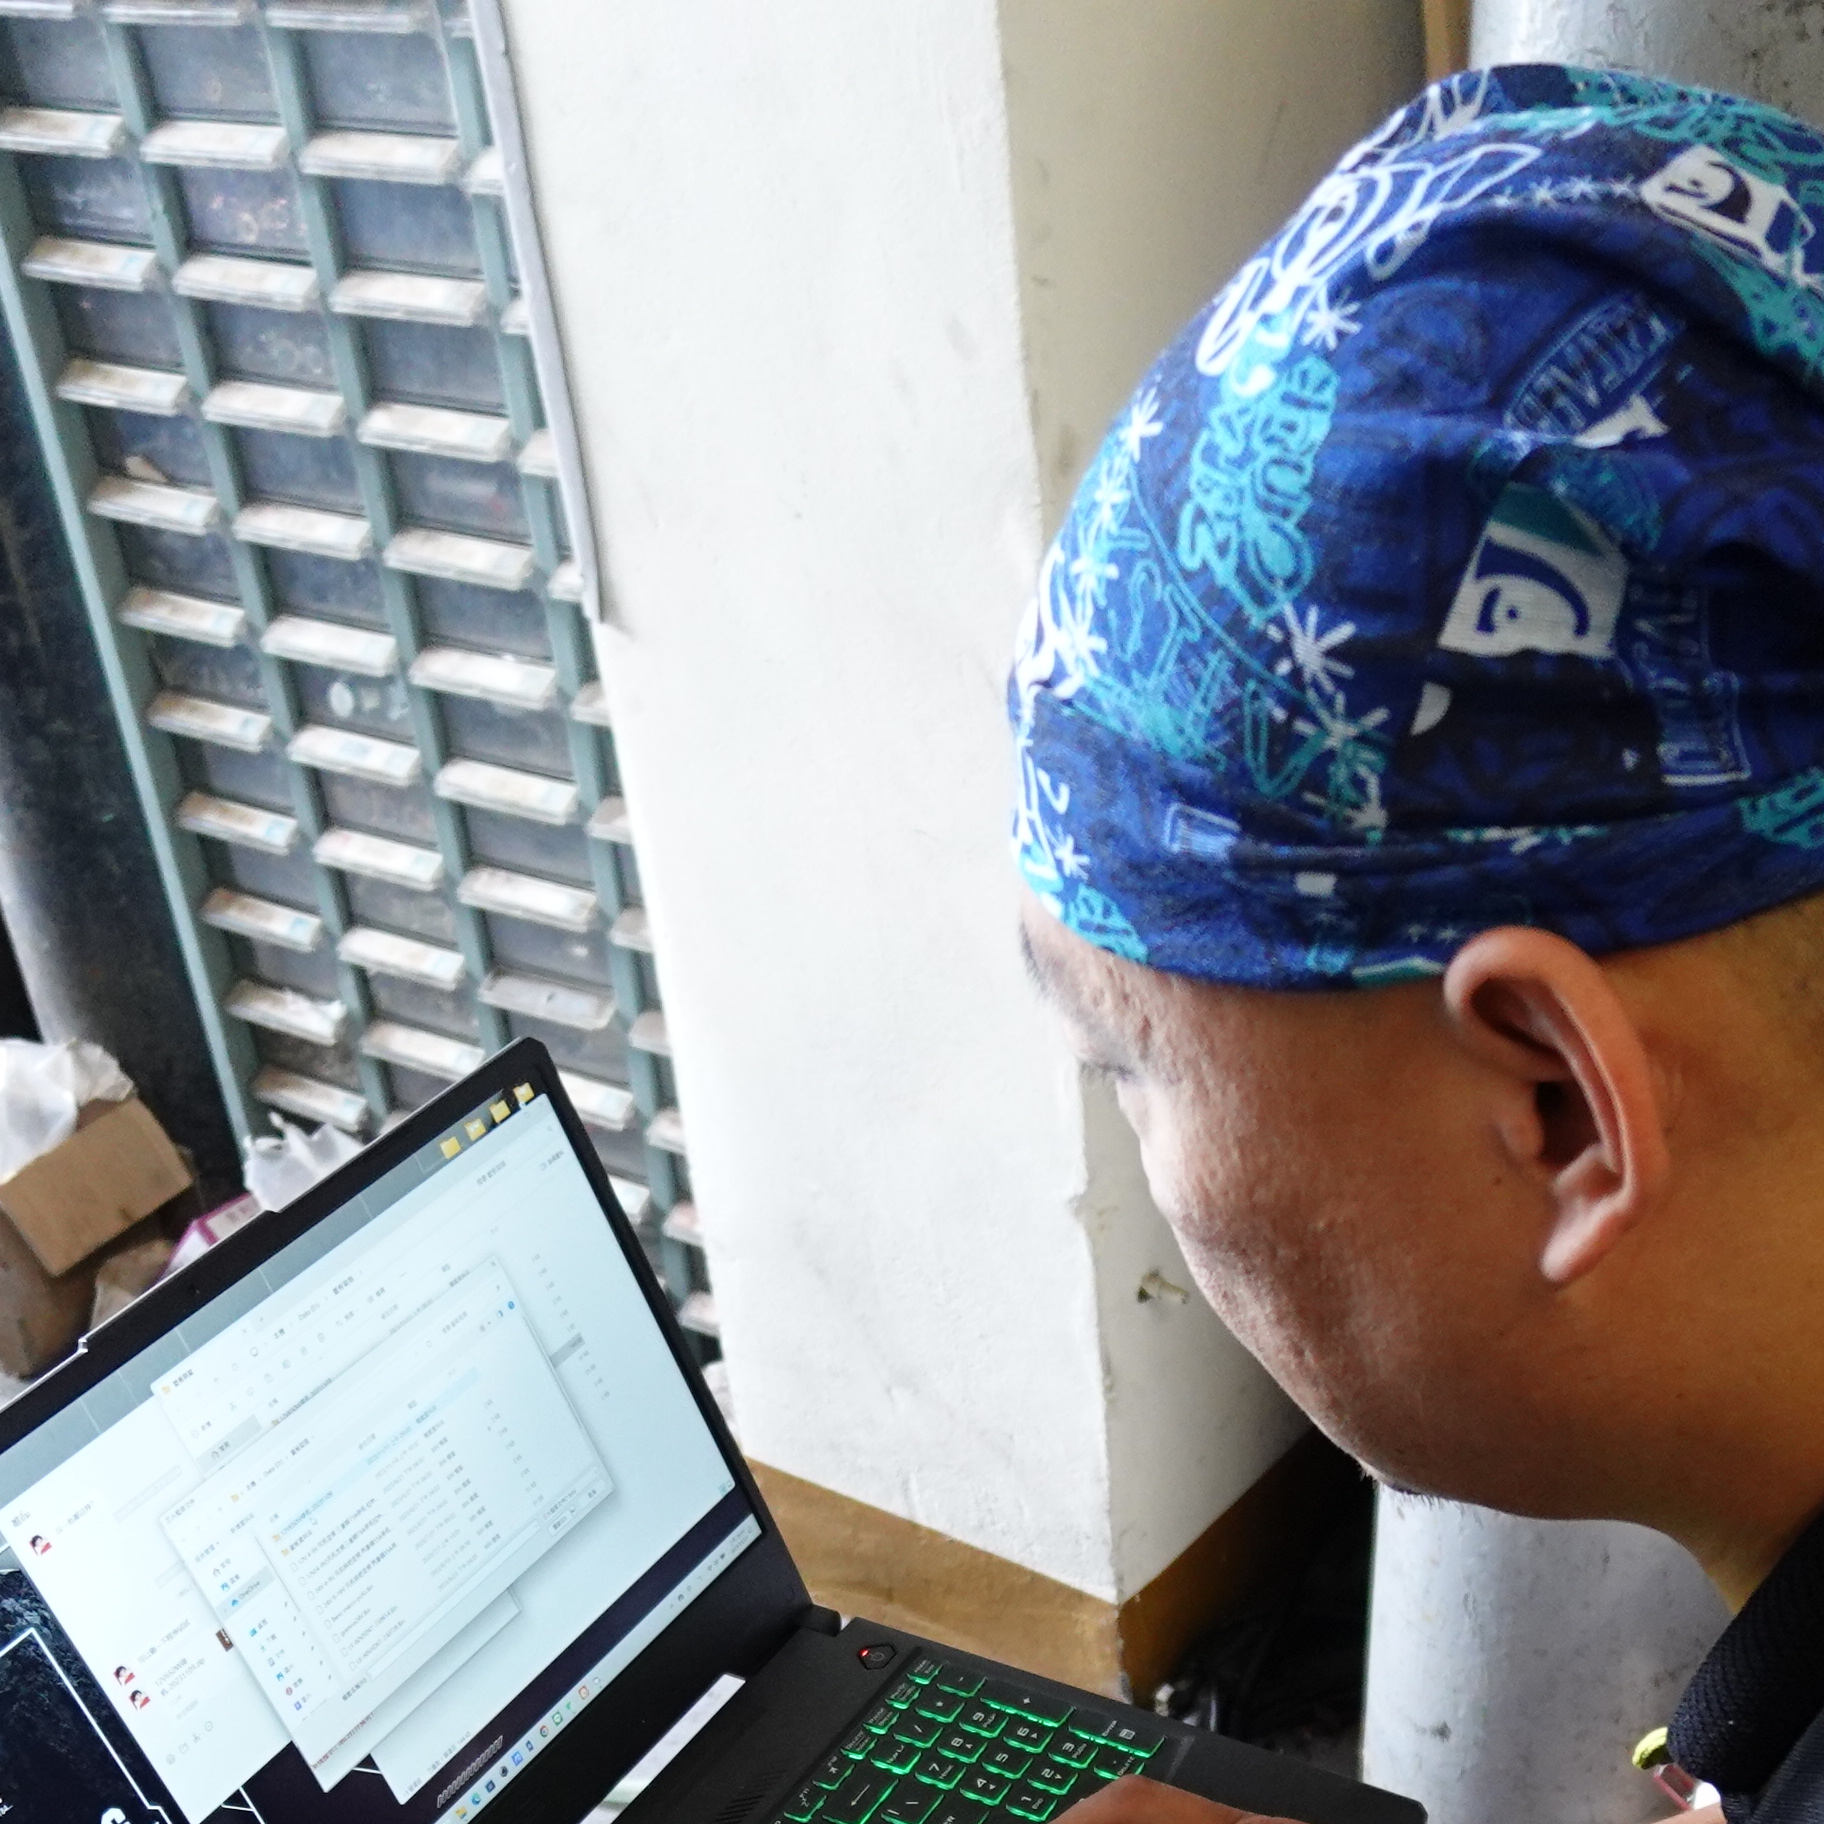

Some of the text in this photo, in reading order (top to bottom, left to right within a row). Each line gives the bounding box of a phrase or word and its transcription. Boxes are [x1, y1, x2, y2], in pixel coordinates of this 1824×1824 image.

[972, 1711, 985, 1722] 9
[1016, 1726, 1030, 1737] 6
[950, 1737, 963, 1747] 8
[1061, 1742, 1075, 1752] 3
[995, 1752, 1009, 1763] 5
[928, 1762, 940, 1771] 7
[1040, 1768, 1054, 1778] 2
[976, 1777, 987, 1788] 4
